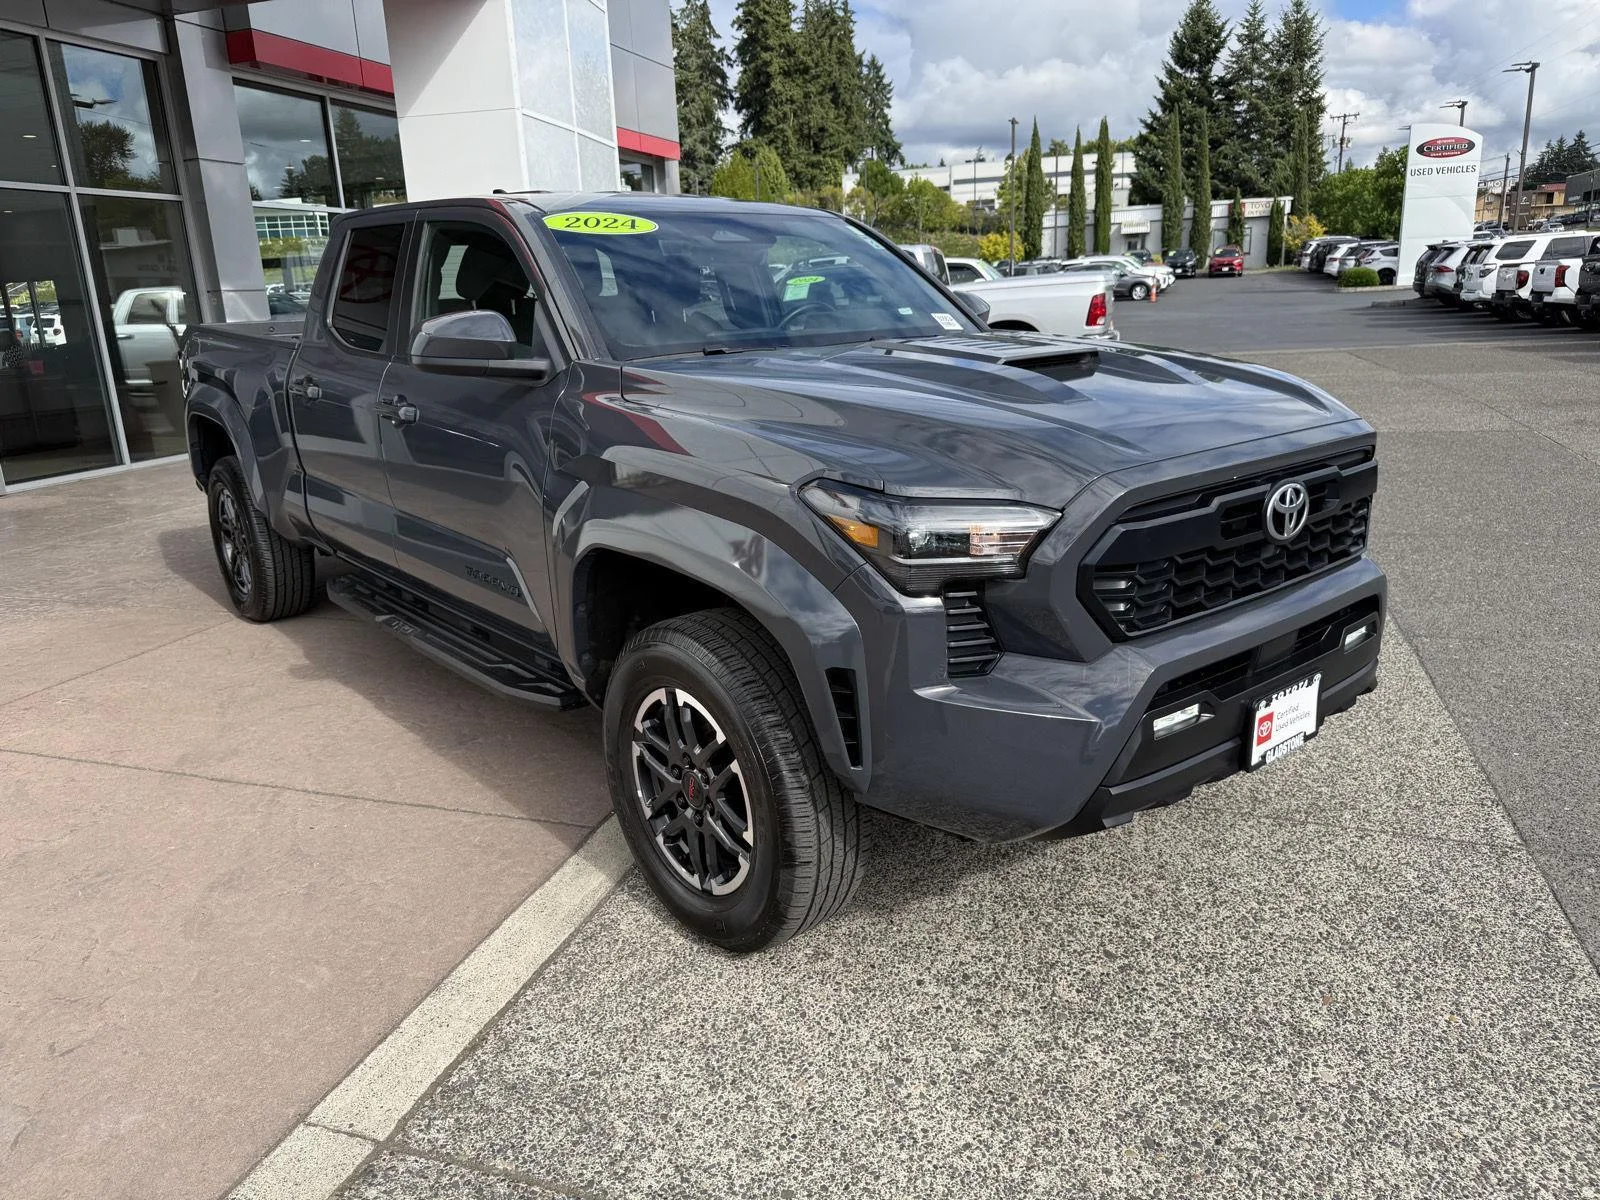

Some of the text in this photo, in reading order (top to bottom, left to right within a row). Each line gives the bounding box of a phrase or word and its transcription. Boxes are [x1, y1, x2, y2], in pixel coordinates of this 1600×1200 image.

[1424, 143, 1468, 152] CERTIFIED
[1410, 164, 1477, 176] USED VEHICLES
[565, 217, 640, 230] 2024
[1265, 731, 1305, 764] GLADSTONE
